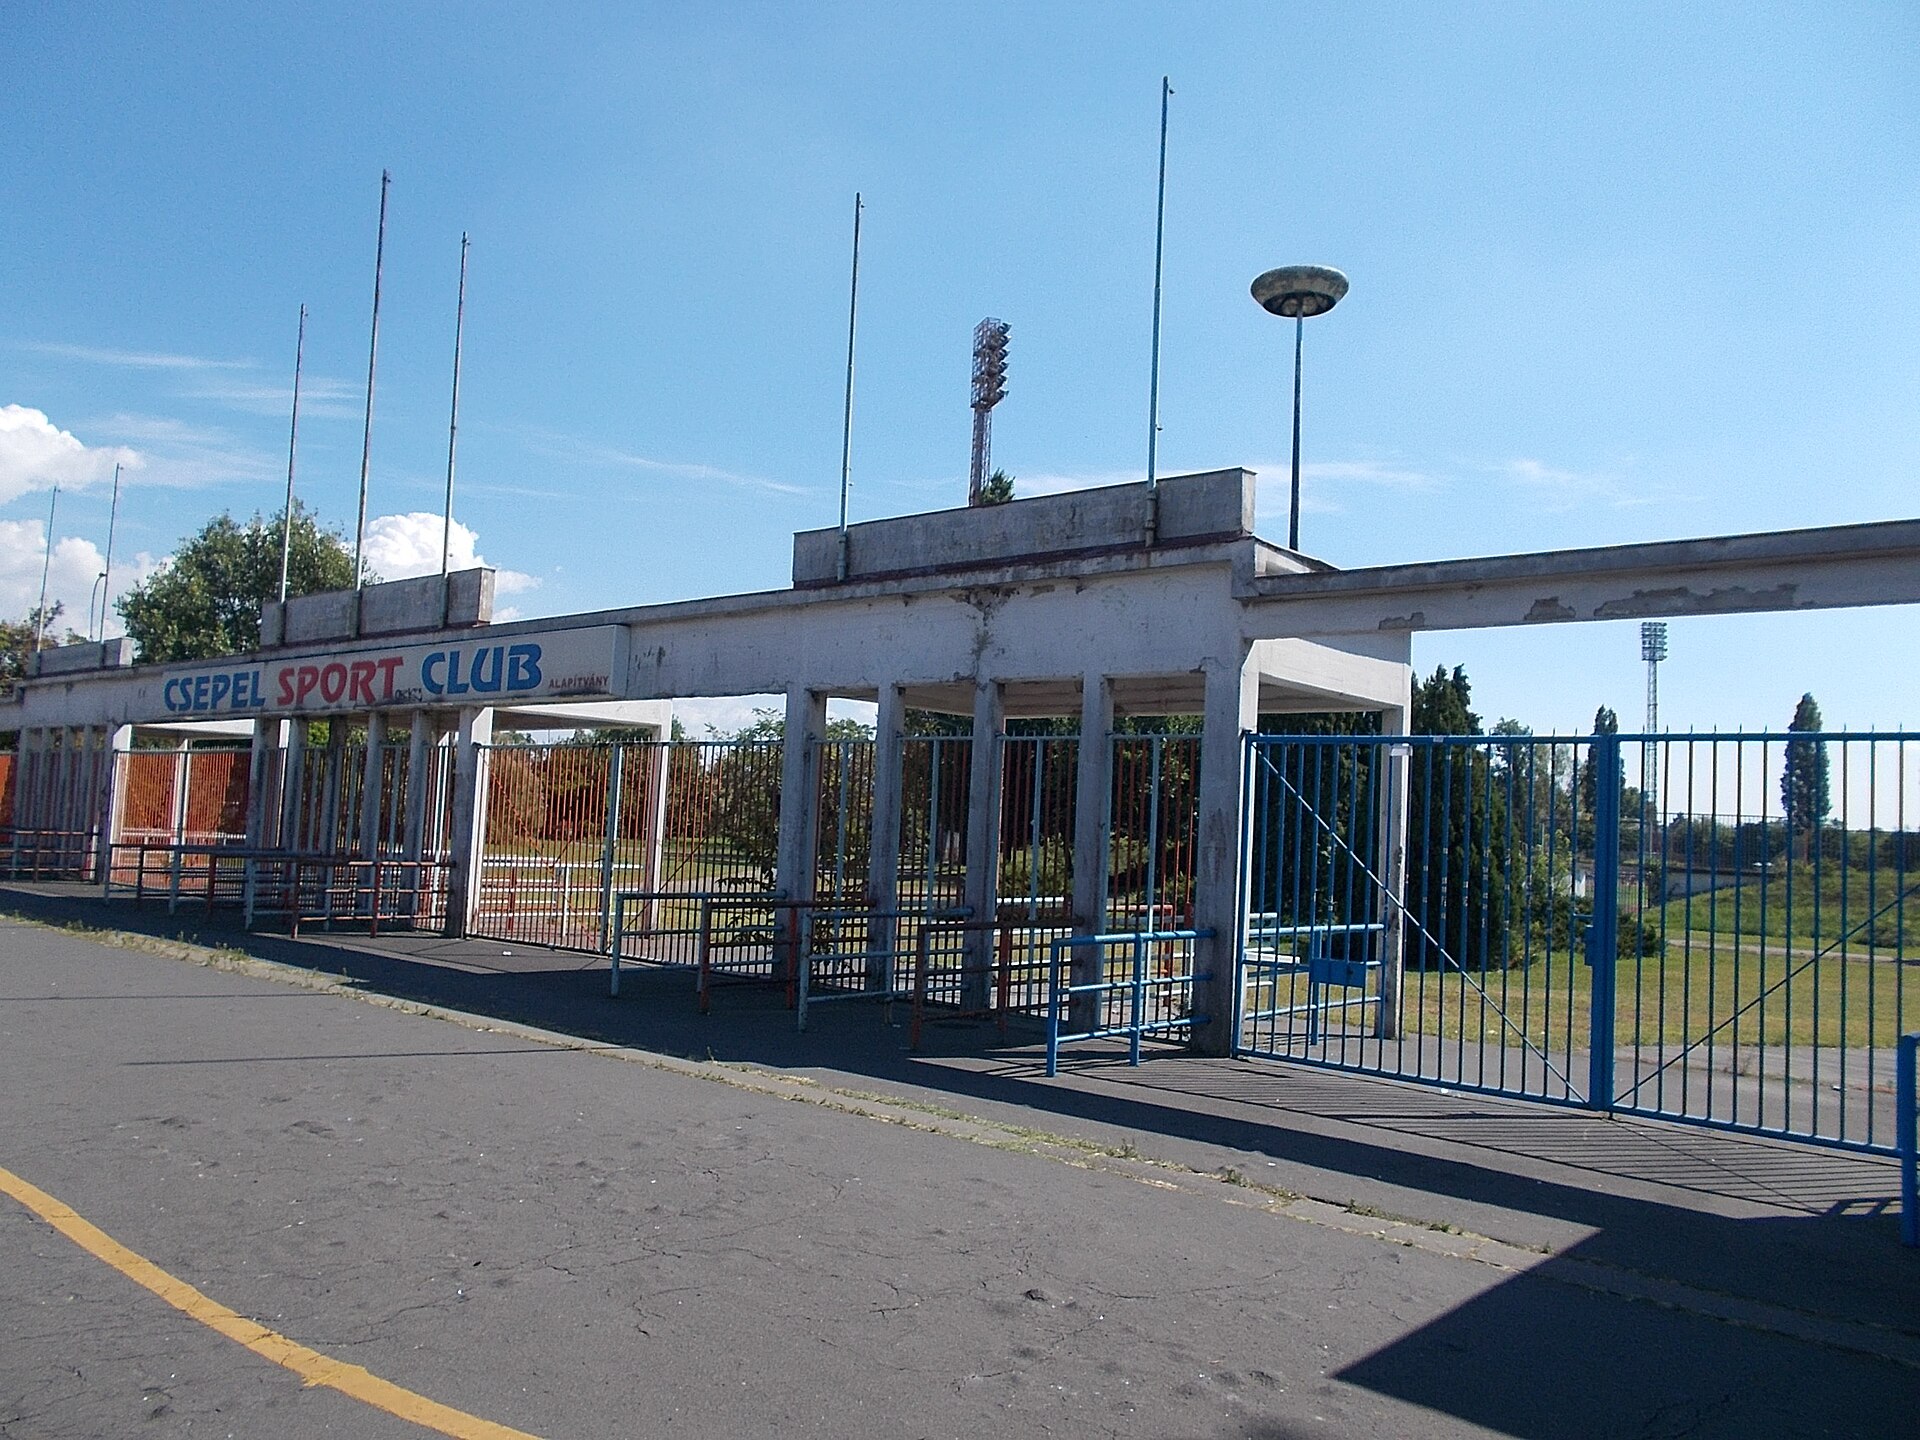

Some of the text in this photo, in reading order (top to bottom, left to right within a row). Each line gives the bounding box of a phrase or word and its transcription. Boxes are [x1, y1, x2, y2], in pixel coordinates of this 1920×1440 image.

[163, 643, 542, 712] CSEPEL SPORT CLUB
[549, 674, 609, 689] ALAPÍTVÁNY
